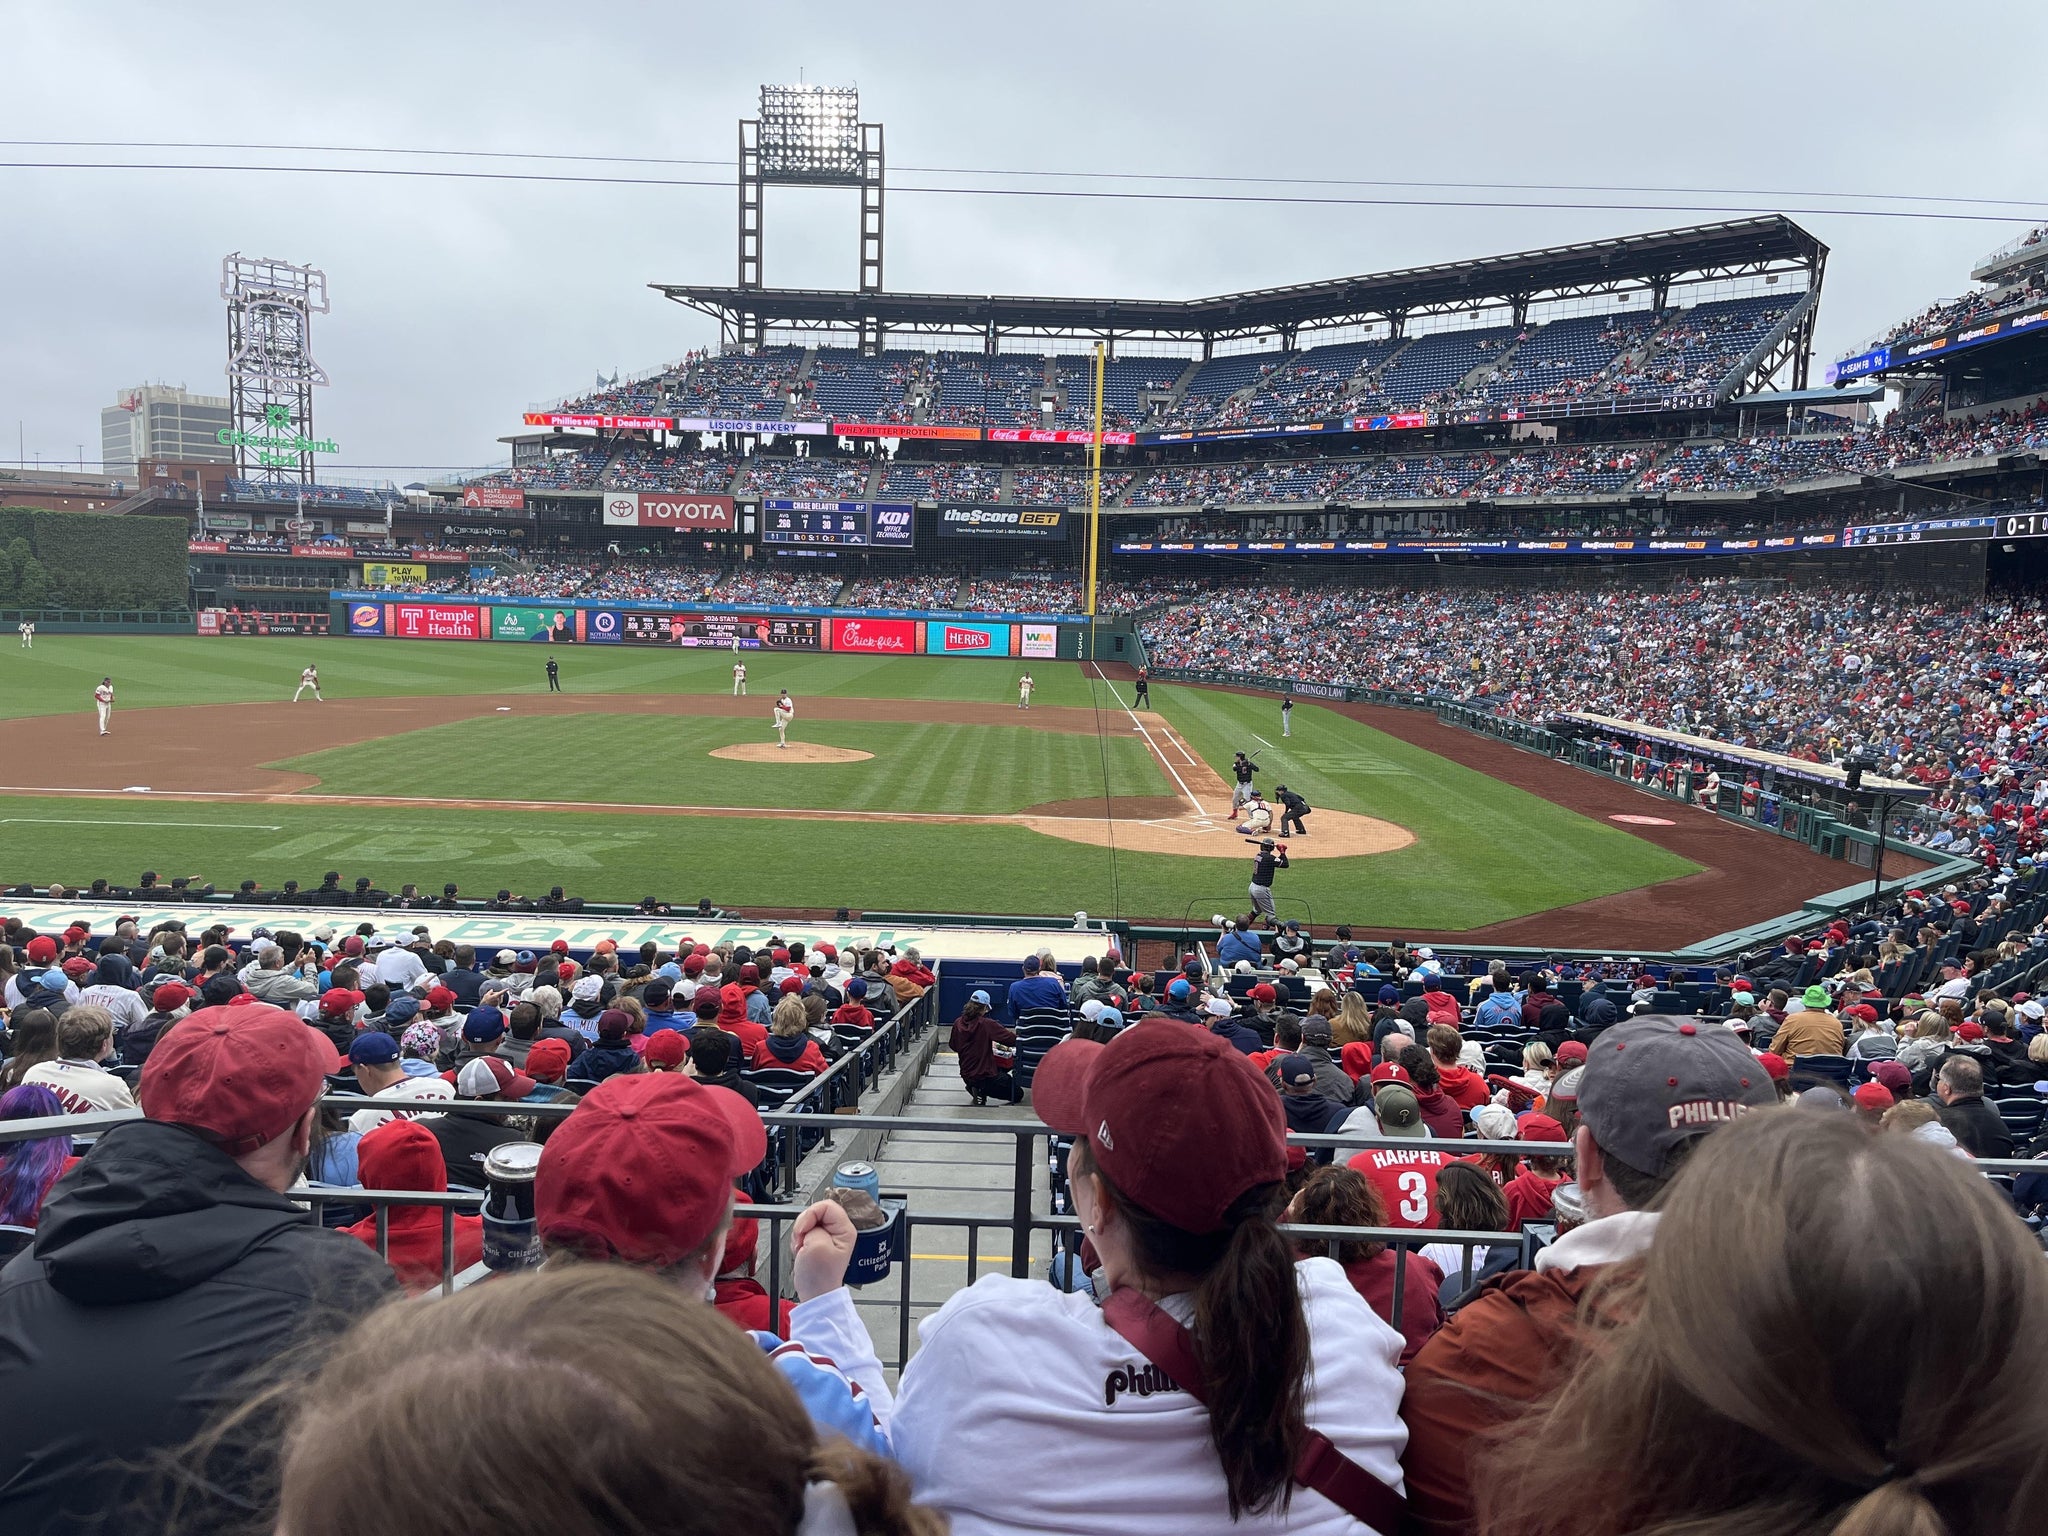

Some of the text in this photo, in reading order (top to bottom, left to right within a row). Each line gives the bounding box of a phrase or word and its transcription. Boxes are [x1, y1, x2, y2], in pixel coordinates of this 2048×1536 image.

[1840, 360, 1861, 375] 4-SEAM
[1862, 359, 1869, 370] FB
[1873, 355, 1882, 366] 96
[1663, 396, 1702, 408] R H E
[551, 416, 666, 428] Phillies win Deals roll in
[709, 421, 797, 432] LISCIO'S BAKERY
[838, 426, 865, 434] WHEY
[868, 427, 898, 435] BETTER
[900, 428, 938, 436] PROTEIN
[217, 428, 336, 453] Citizens Bank
[259, 451, 298, 467] Park
[643, 502, 726, 521] TOYOTA
[792, 501, 811, 510] CHASE
[811, 502, 839, 511] DELAUTER
[876, 511, 911, 525] KDI
[943, 508, 1057, 524] theScore BET
[1979, 518, 1986, 526] LA
[802, 519, 808, 529] 7
[875, 531, 910, 539] TECHNOLOGY
[1896, 533, 1904, 542] 30
[188, 542, 220, 551] dweiser
[311, 547, 347, 557] Budweiser
[391, 566, 412, 575] PLAY
[401, 575, 422, 583] WIN!
[401, 608, 423, 634] T
[427, 609, 475, 622] Temple
[428, 623, 472, 636] Health
[842, 623, 904, 649] Chick-fil-A
[698, 638, 732, 646] FOUR-SEAM
[949, 632, 985, 646] HERR'S
[1026, 632, 1053, 642] WM
[1295, 683, 1343, 698] GRUNGO LAW
[247, 832, 641, 868] IBX
[443, 920, 699, 946] Bank
[1389, 1064, 1400, 1077] P
[1668, 1101, 1758, 1129] PHILLIE
[1372, 1149, 1442, 1169] HARPER
[1398, 1171, 1428, 1222] 3
[858, 1252, 887, 1267] Citizens
[874, 1262, 887, 1272] Park
